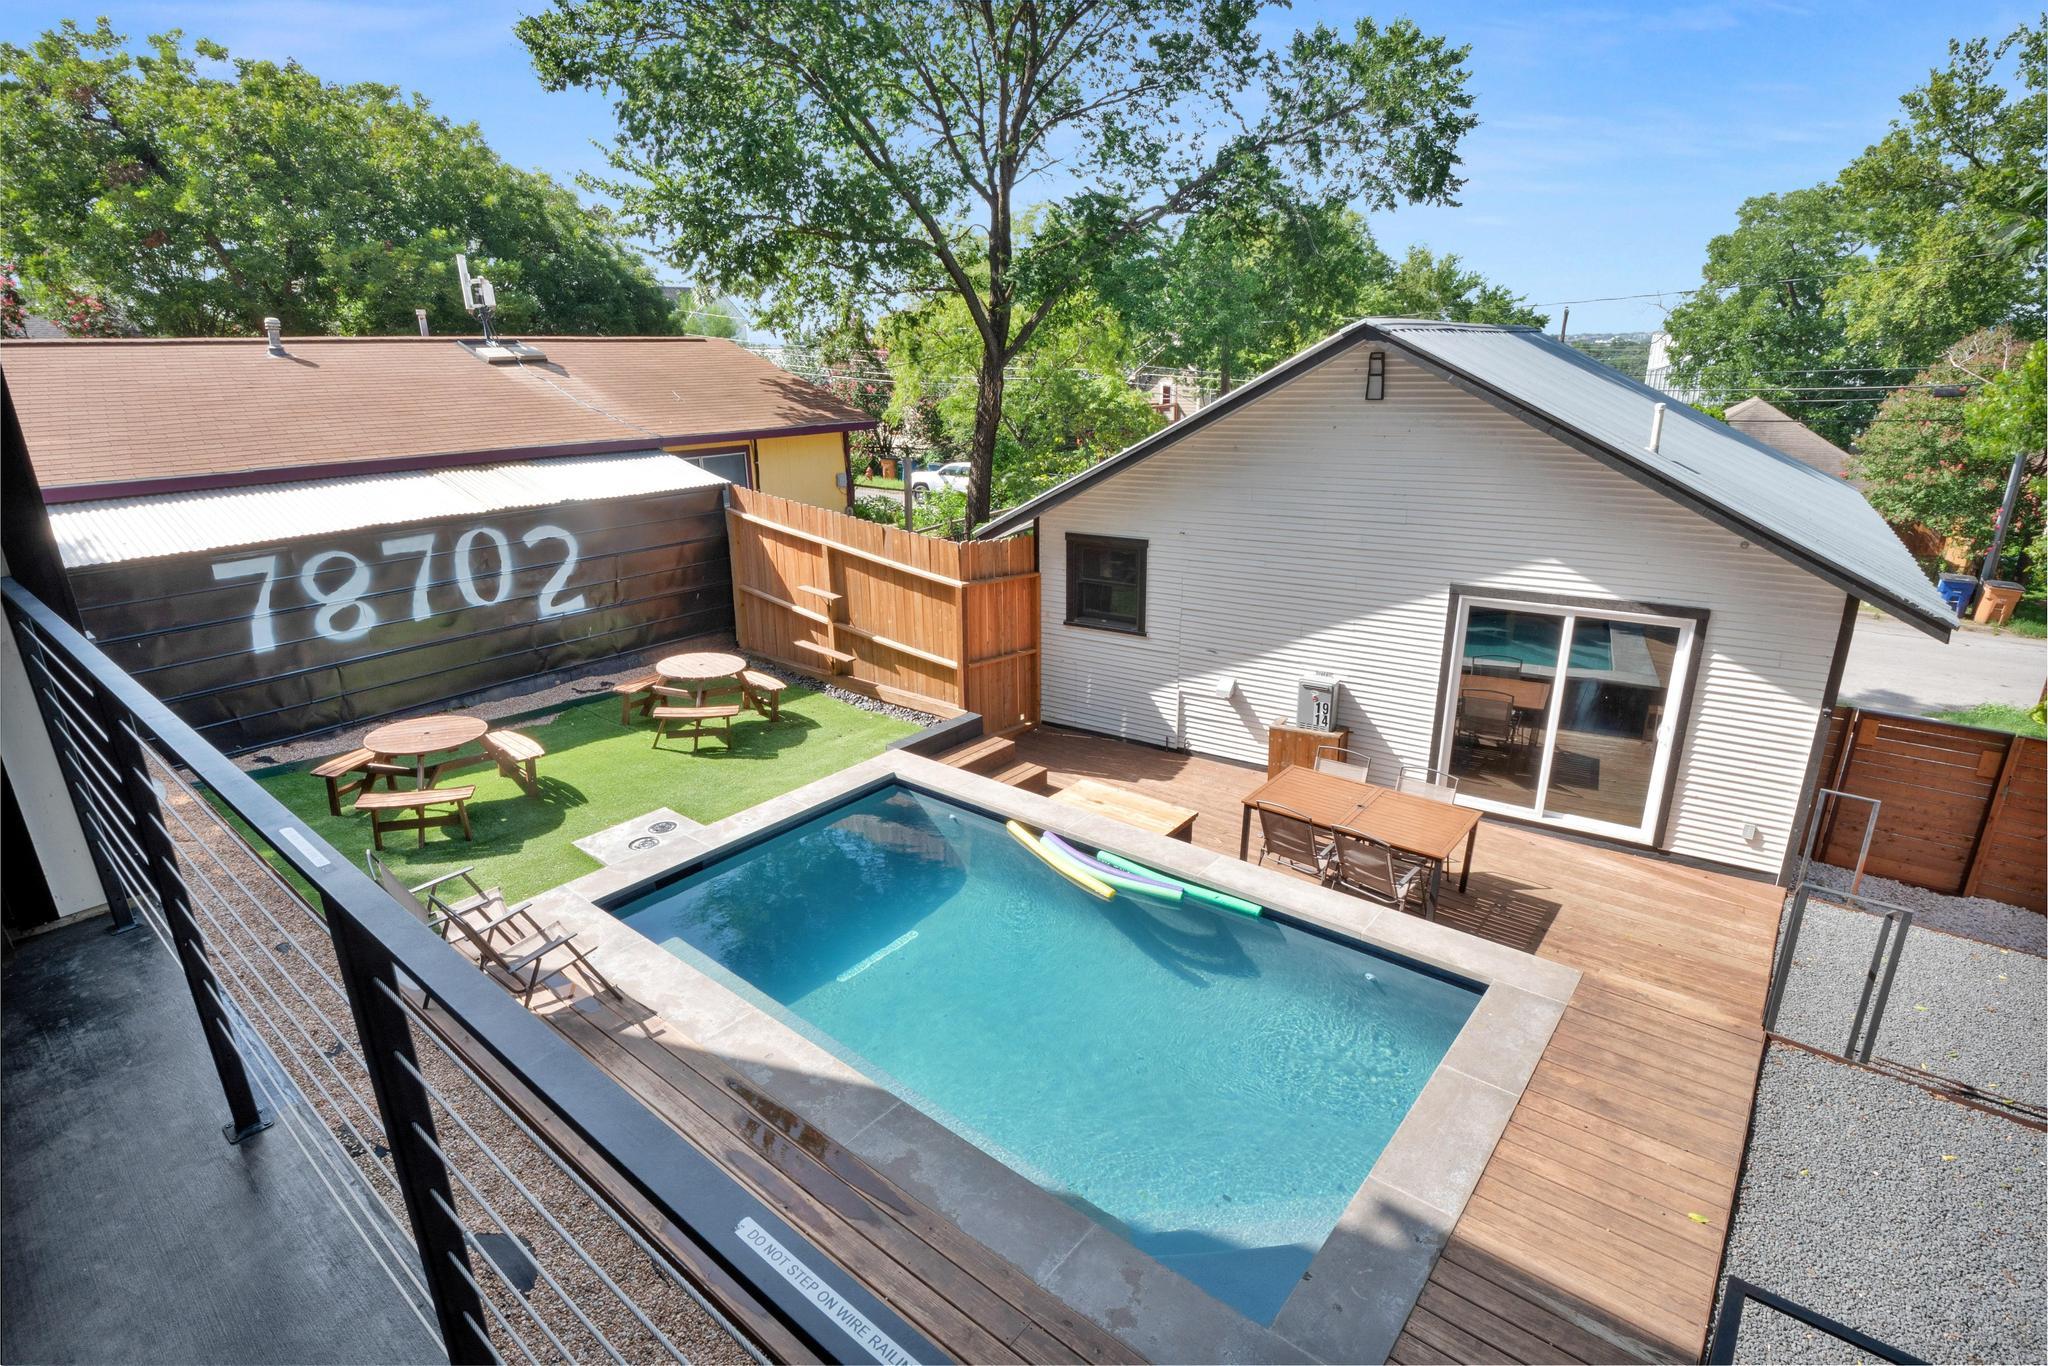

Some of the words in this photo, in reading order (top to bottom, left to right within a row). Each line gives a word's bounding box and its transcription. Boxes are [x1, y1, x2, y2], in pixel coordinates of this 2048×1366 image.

[211, 524, 586, 654] 78702
[1315, 702, 1329, 715] 19
[1315, 714, 1328, 727] 14
[747, 1229, 767, 1246] DO
[764, 1244, 791, 1266] NOT
[786, 1264, 819, 1290] STEP
[817, 1290, 839, 1311] ON
[836, 1305, 872, 1339] WIRE
